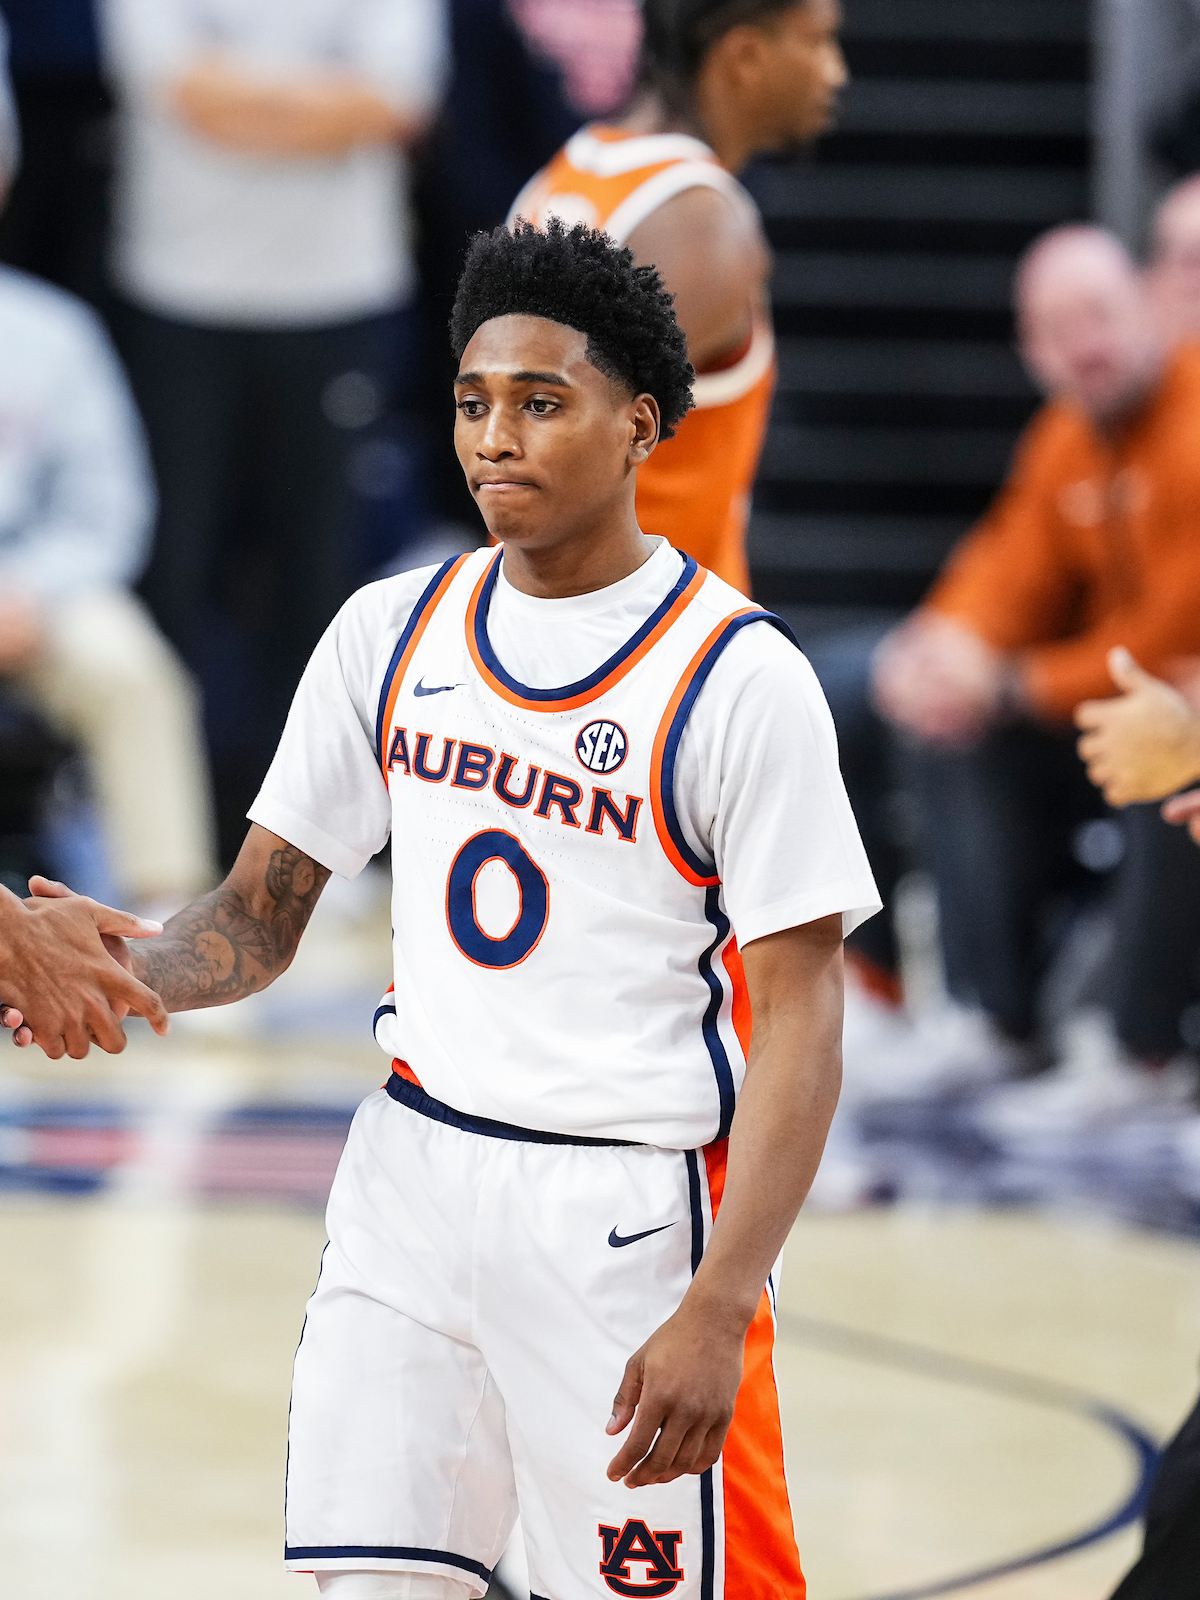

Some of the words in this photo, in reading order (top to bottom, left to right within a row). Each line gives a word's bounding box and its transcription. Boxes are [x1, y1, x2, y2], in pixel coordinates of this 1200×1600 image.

[388, 727, 643, 843] AUBURN
[577, 721, 628, 773] SEC
[446, 829, 550, 970] 0
